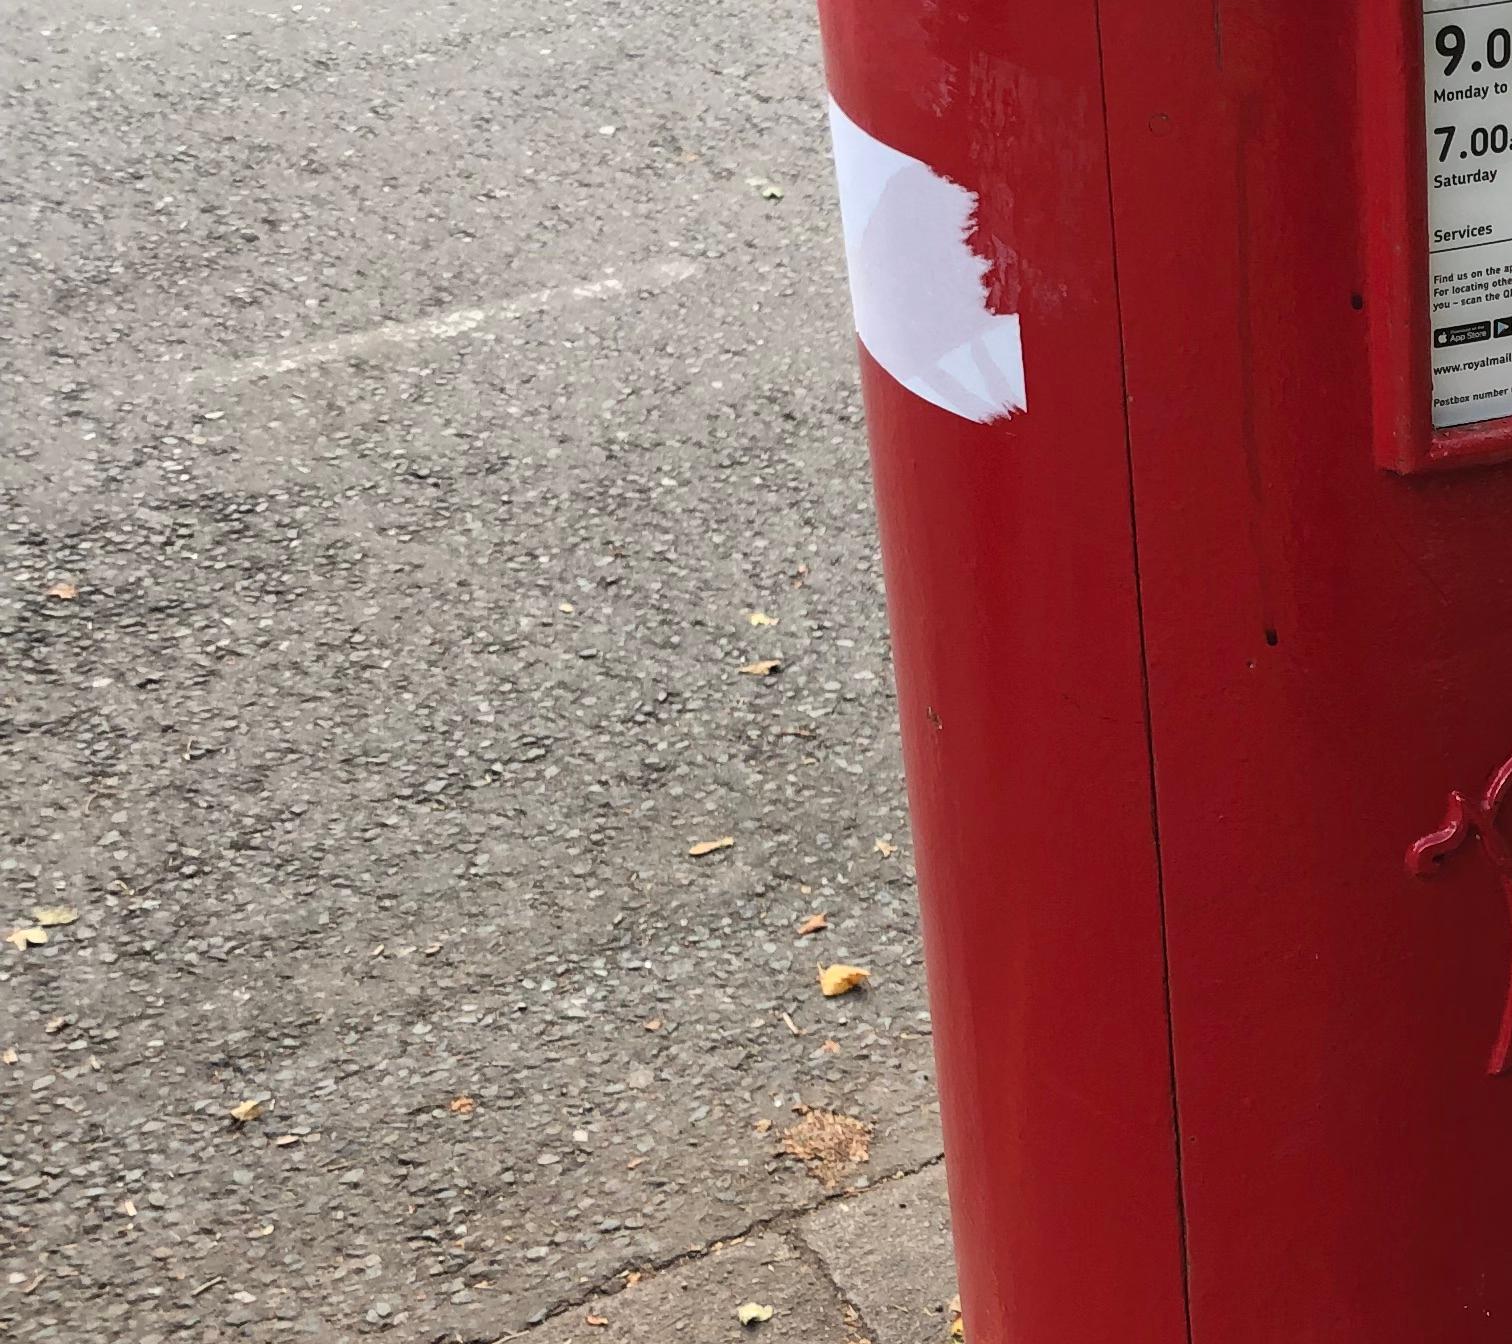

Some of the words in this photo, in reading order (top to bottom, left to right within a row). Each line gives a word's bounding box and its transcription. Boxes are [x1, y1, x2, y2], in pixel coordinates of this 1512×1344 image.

[1434, 85, 1489, 103] Monday
[1494, 81, 1507, 95] to
[1434, 169, 1497, 188] Saturday
[1434, 225, 1493, 243] Services
[1434, 273, 1453, 284] Find
[1457, 270, 1468, 281] us
[1471, 270, 1482, 279] on
[1486, 266, 1500, 276] the
[1434, 288, 1449, 297] For
[1452, 281, 1489, 294] locating
[1433, 302, 1450, 311] you
[1461, 296, 1482, 306] scan
[1486, 292, 1500, 301] the
[1467, 331, 1486, 339] Store
[1433, 394, 1470, 407] Postbox
[1473, 388, 1508, 401] number
